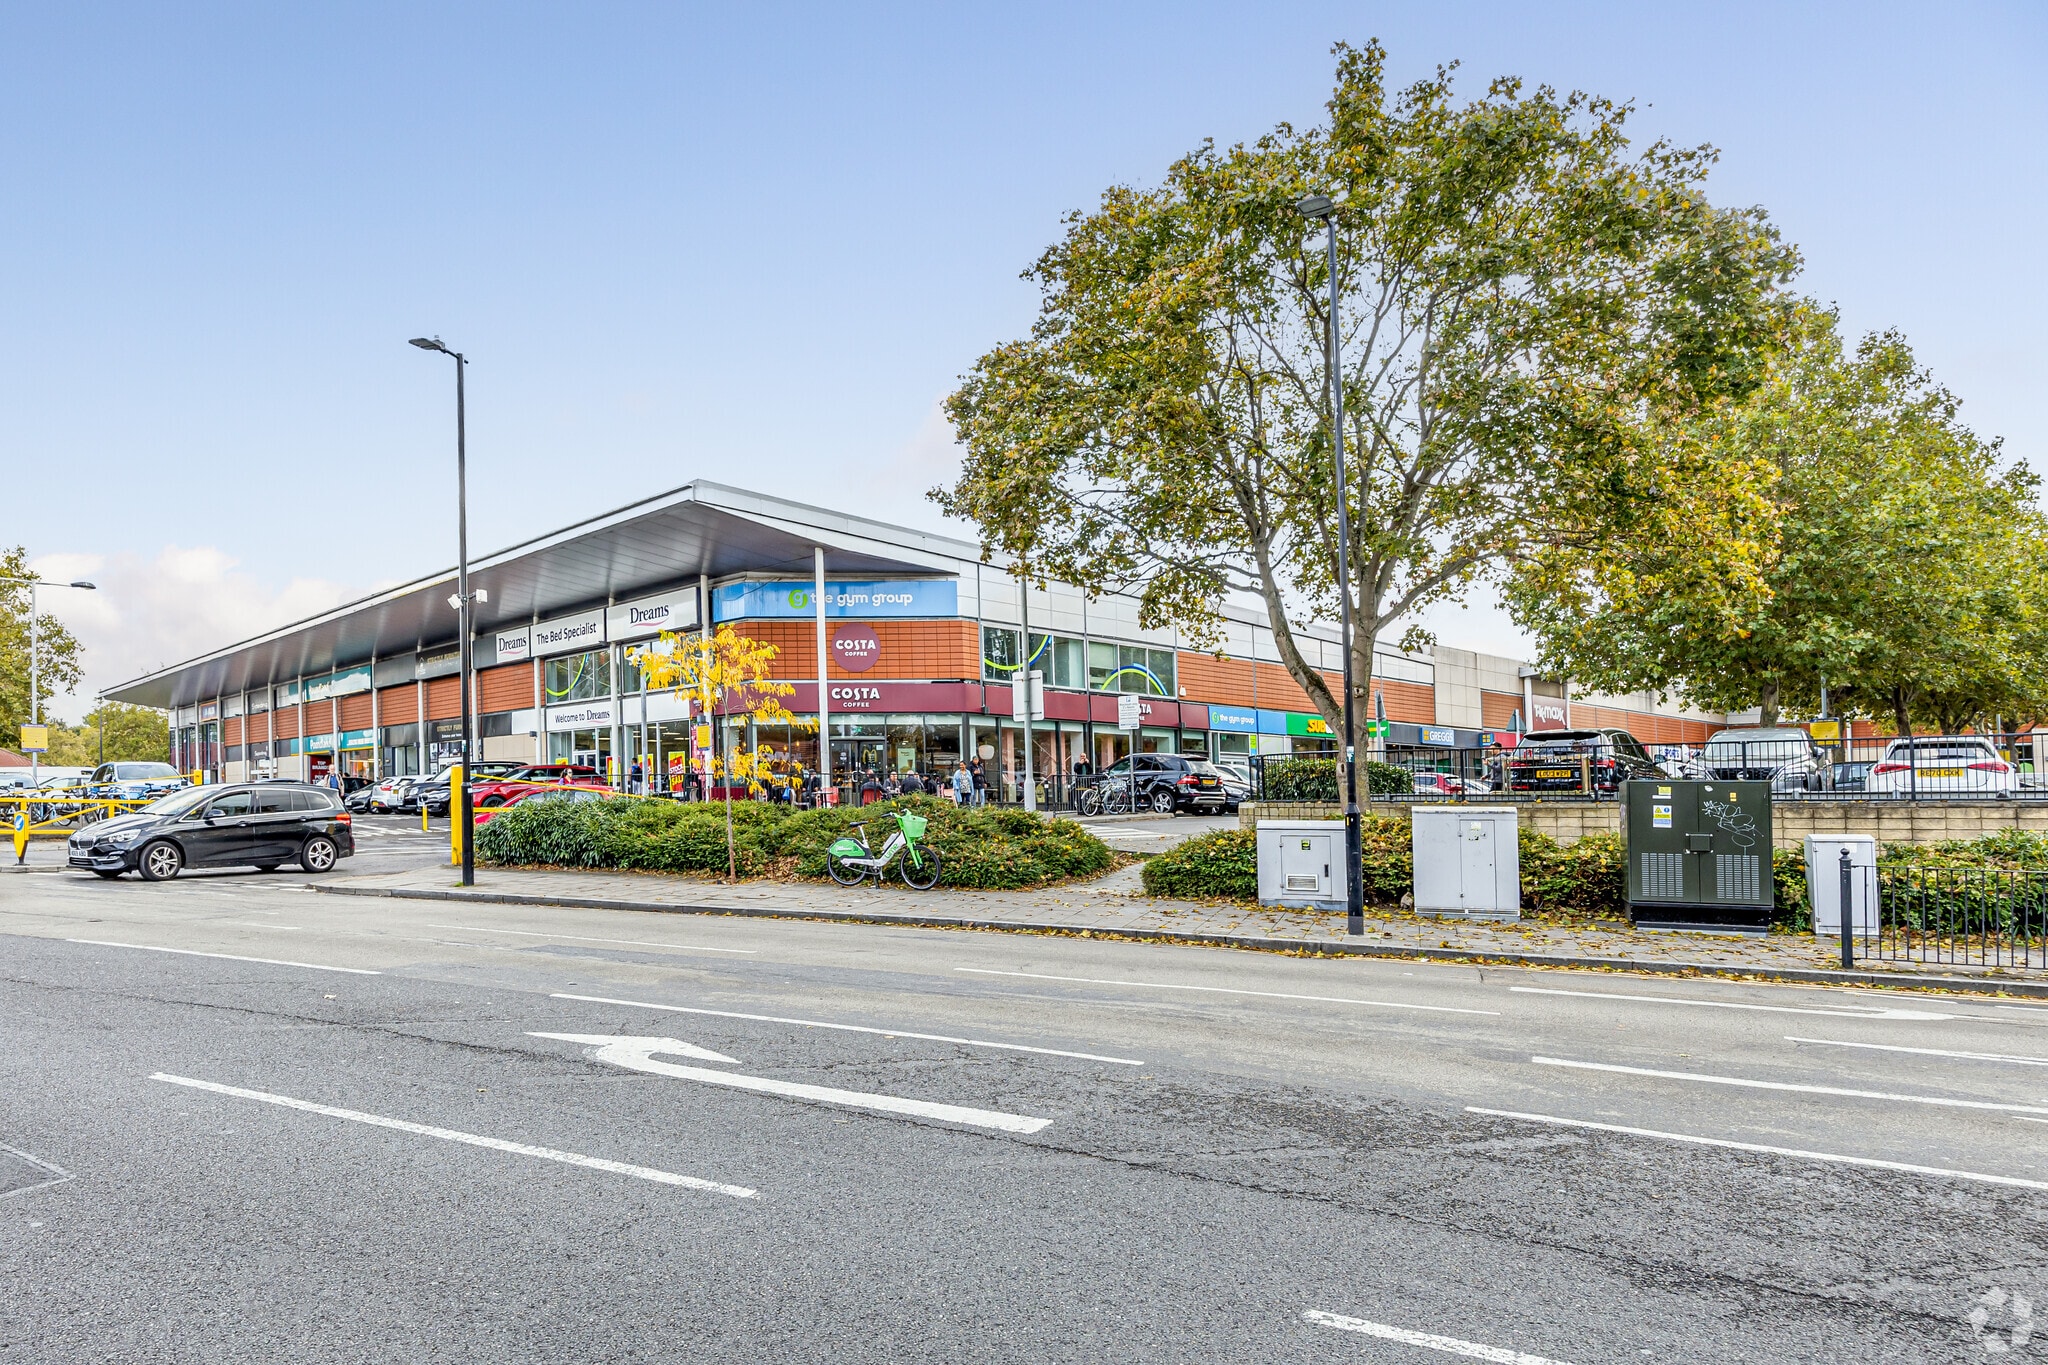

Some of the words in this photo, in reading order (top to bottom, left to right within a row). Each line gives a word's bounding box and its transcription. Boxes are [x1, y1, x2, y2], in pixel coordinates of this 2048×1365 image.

[810, 592, 833, 603] te
[837, 593, 868, 607] gym
[872, 593, 913, 607] group
[629, 604, 669, 624] Dreams
[537, 633, 549, 646] The
[550, 630, 562, 643] Bed
[563, 622, 597, 642] Specialist
[499, 635, 527, 652] Dreams
[835, 639, 876, 651] COSTA
[831, 687, 880, 701] COSTA
[554, 713, 579, 723] Welcome
[579, 713, 585, 721] to
[586, 710, 610, 720] Dreams
[1219, 713, 1229, 722] the
[1229, 715, 1240, 724] gym
[1240, 716, 1255, 725] group
[1429, 730, 1453, 742] GREGGS
[885, 843, 899, 859] Lime
